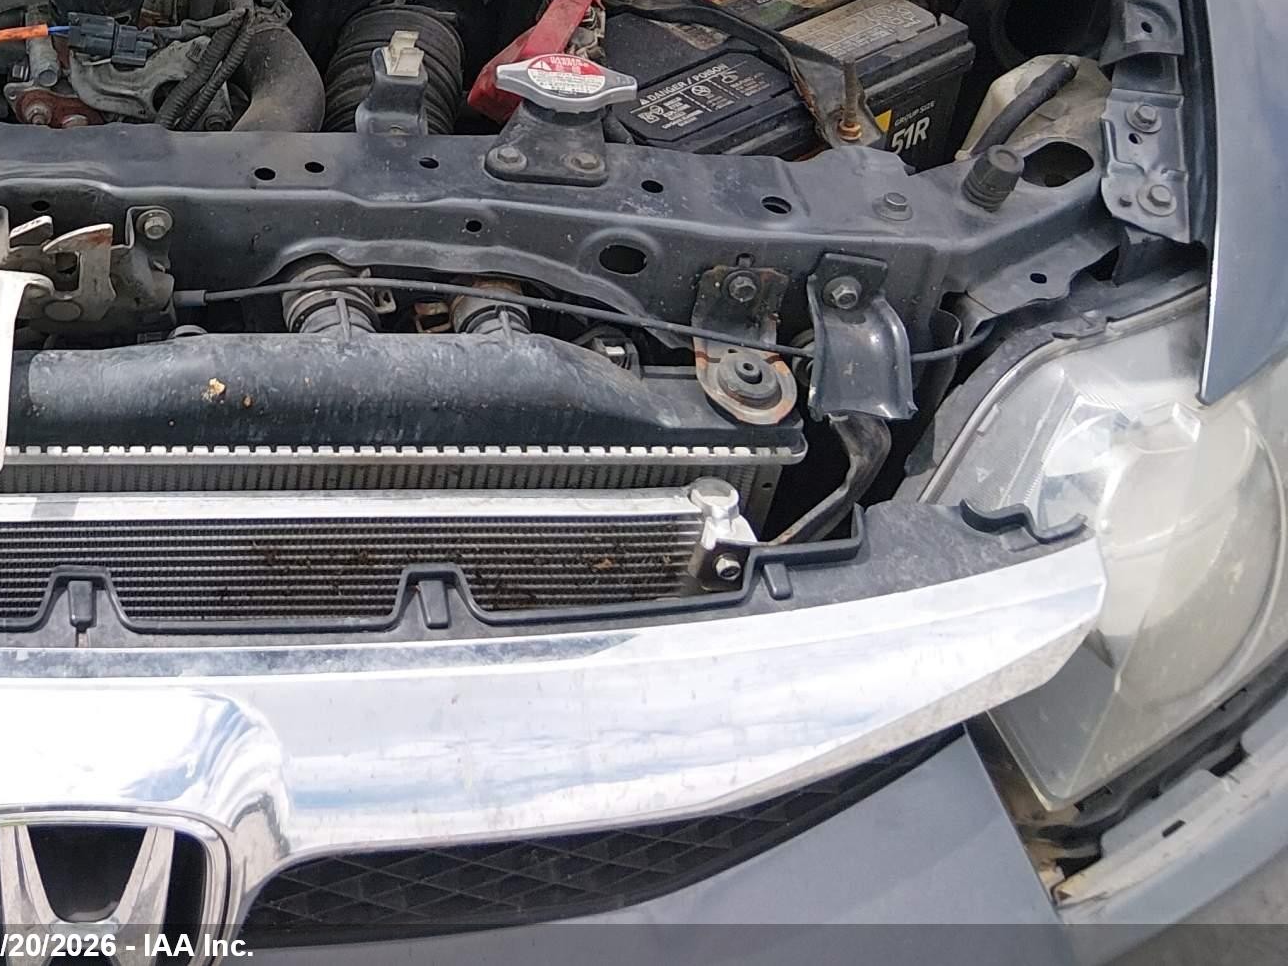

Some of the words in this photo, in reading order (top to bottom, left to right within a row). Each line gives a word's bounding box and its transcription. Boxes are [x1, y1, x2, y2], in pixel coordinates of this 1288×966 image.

[646, 79, 688, 102] DANGER
[692, 63, 729, 81] POISON
[892, 116, 930, 155] 51R
